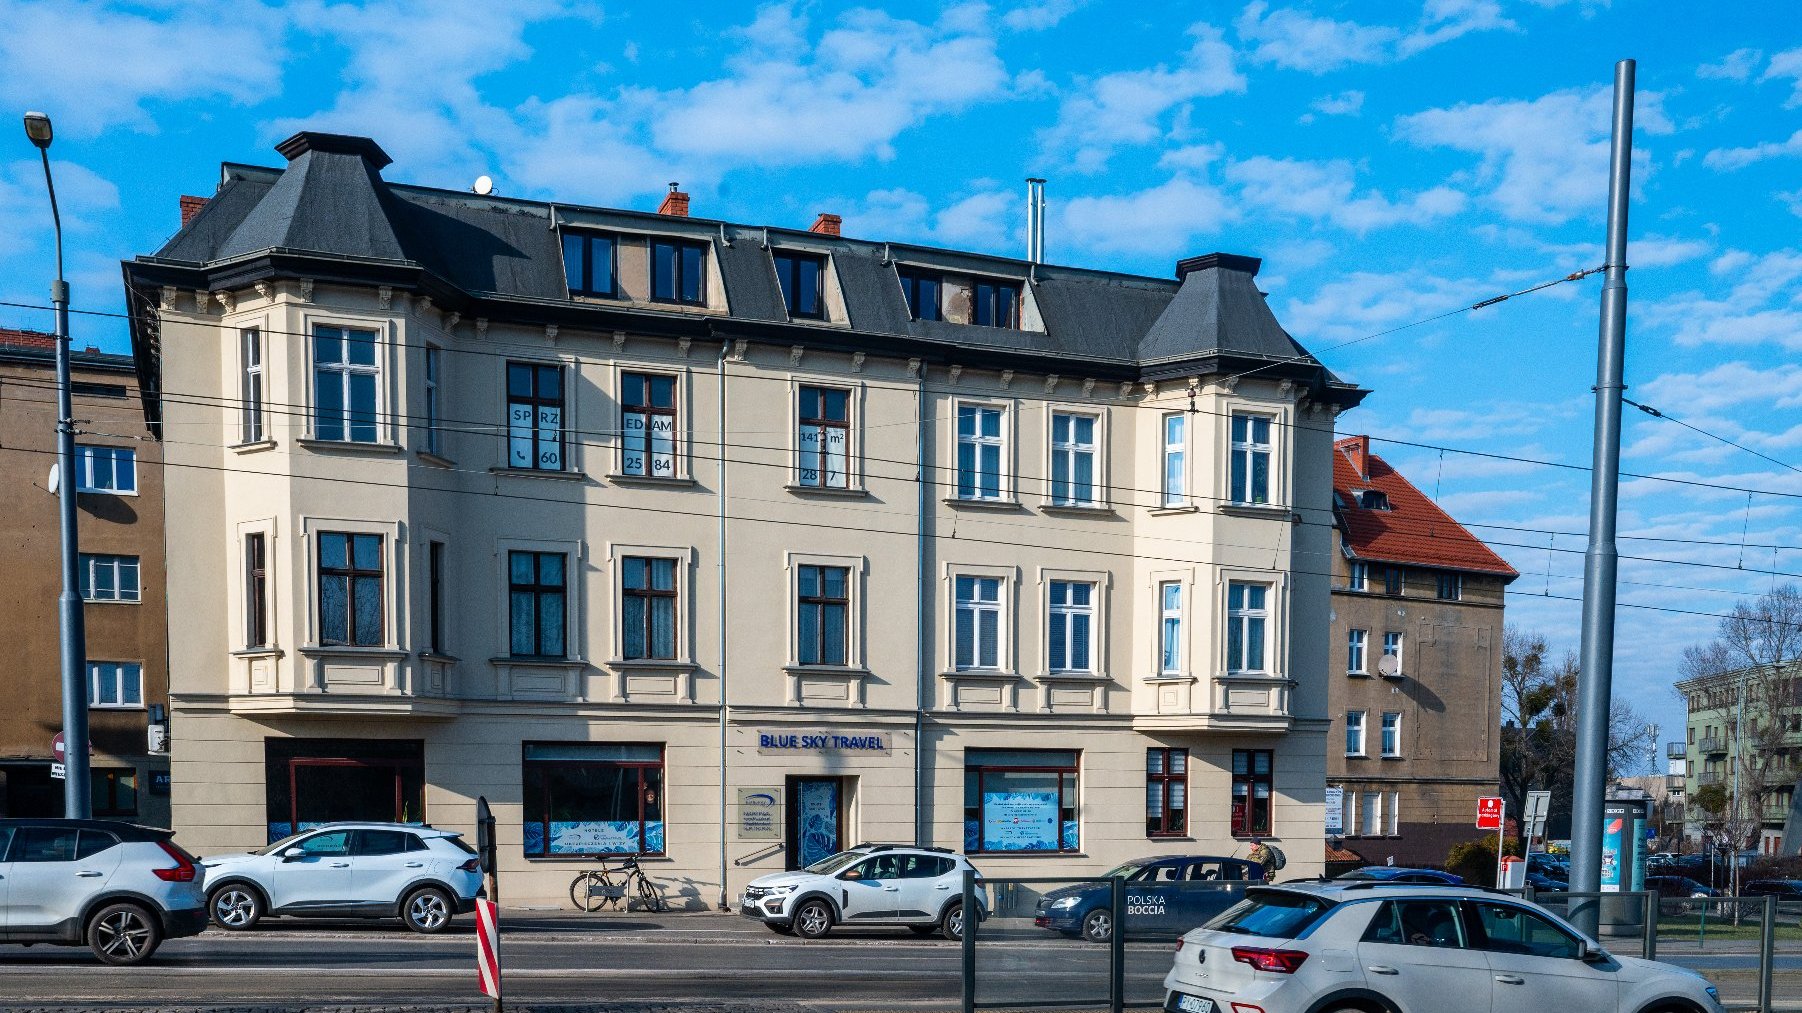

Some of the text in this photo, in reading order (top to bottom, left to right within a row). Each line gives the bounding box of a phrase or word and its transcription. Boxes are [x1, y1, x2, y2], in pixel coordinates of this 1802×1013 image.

[800, 432, 819, 443] 141
[541, 451, 558, 464] 60
[626, 457, 671, 471] 25 84
[802, 469, 818, 481] 28
[760, 734, 884, 749] BLUE SKY TRAVEL
[1127, 895, 1166, 905] POLSKA
[1127, 905, 1166, 915] BOCCIA
